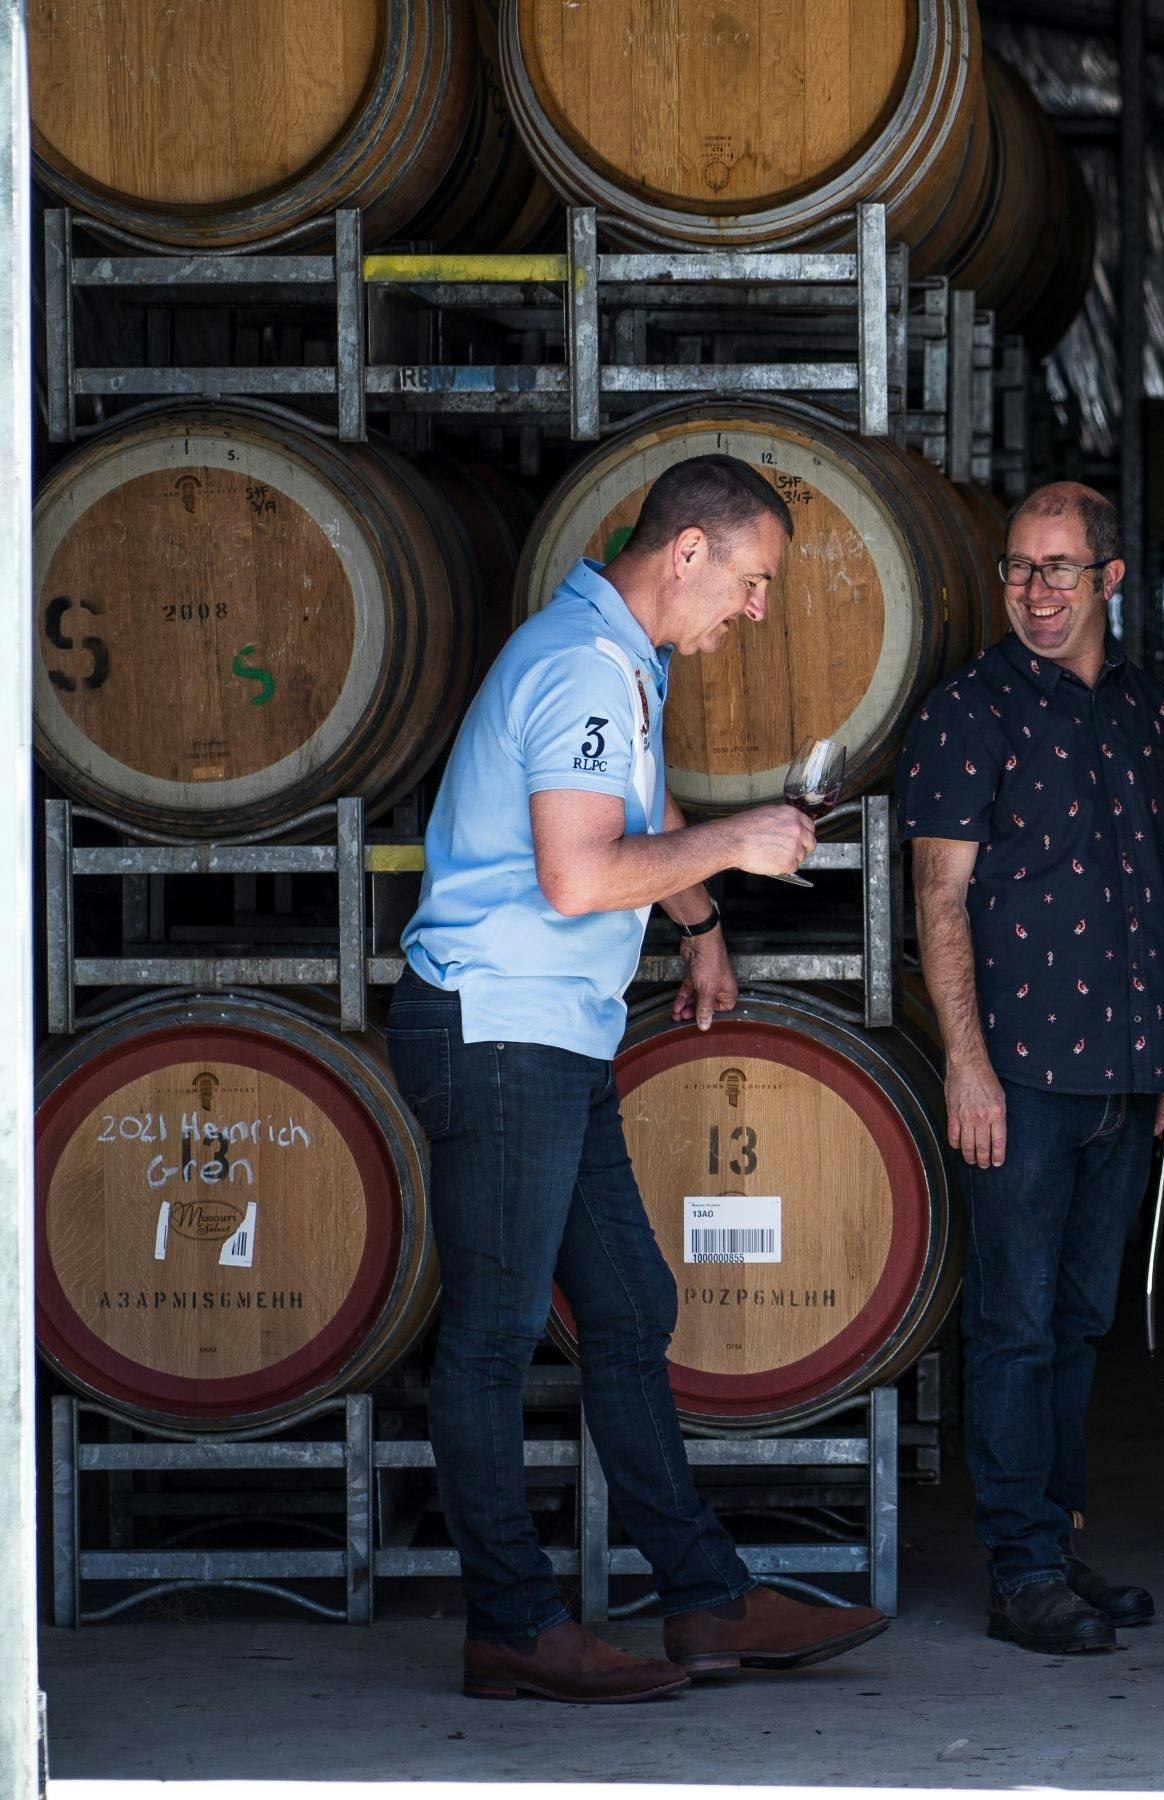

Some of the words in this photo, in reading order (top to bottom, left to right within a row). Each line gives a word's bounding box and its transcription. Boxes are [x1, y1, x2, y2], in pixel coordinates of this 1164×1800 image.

[163, 602, 228, 622] 2008
[44, 595, 109, 693] S
[232, 642, 276, 706] S
[581, 716, 609, 759] 3
[573, 757, 608, 773] RLPC
[97, 1112, 168, 1143] 2021
[181, 1111, 311, 1149] Heinrich
[709, 1125, 758, 1175] 13
[147, 1154, 254, 1188] Gren
[171, 1201, 238, 1229] Missouri
[692, 1253, 745, 1264] 1000000855
